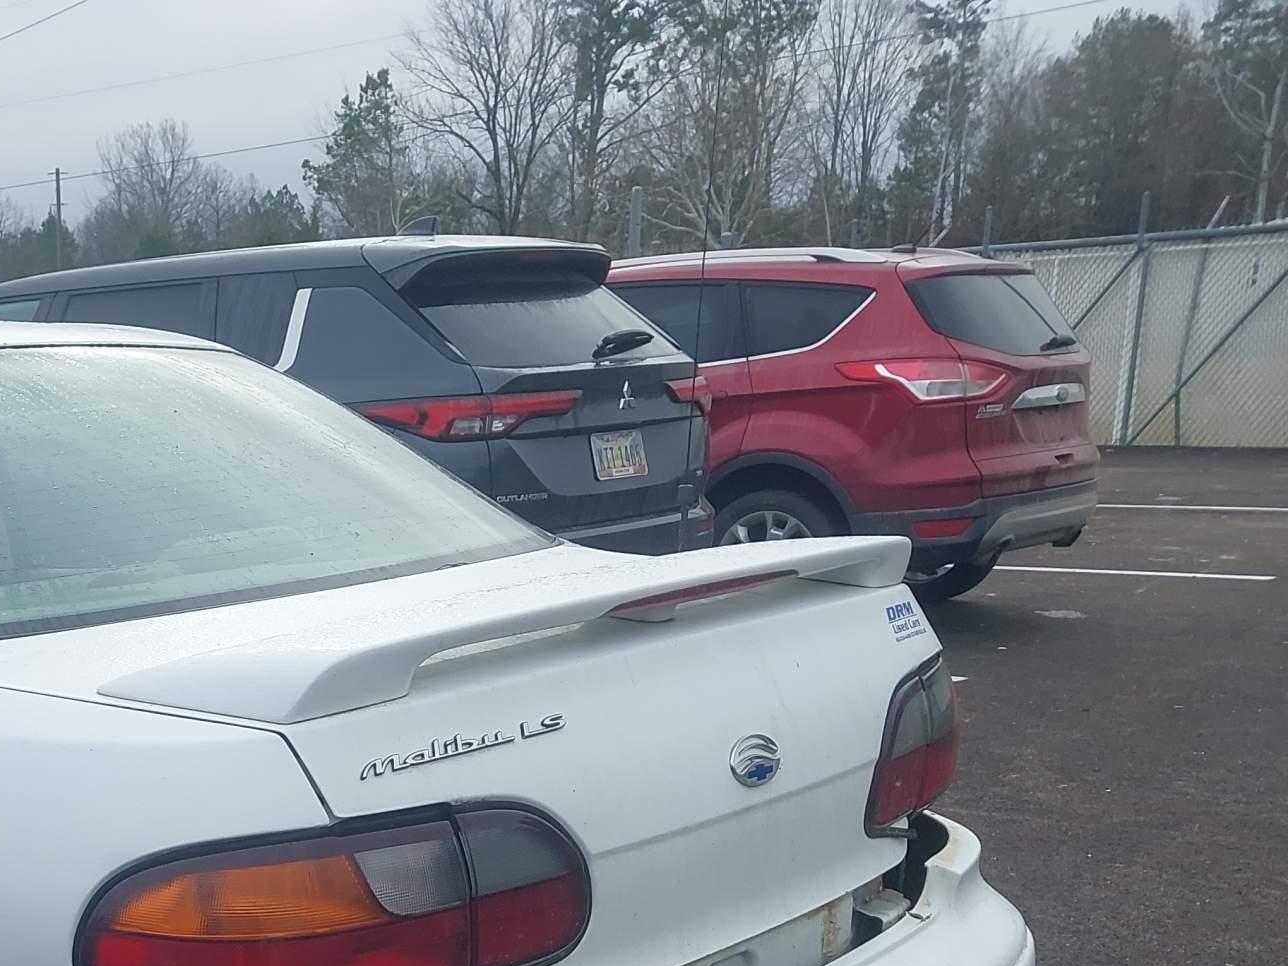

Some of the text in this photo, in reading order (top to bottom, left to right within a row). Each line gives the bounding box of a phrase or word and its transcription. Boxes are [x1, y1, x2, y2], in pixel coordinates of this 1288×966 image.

[886, 601, 915, 622] DRM
[892, 618, 921, 634] Used Cars
[360, 712, 568, 780] Malibu LS
